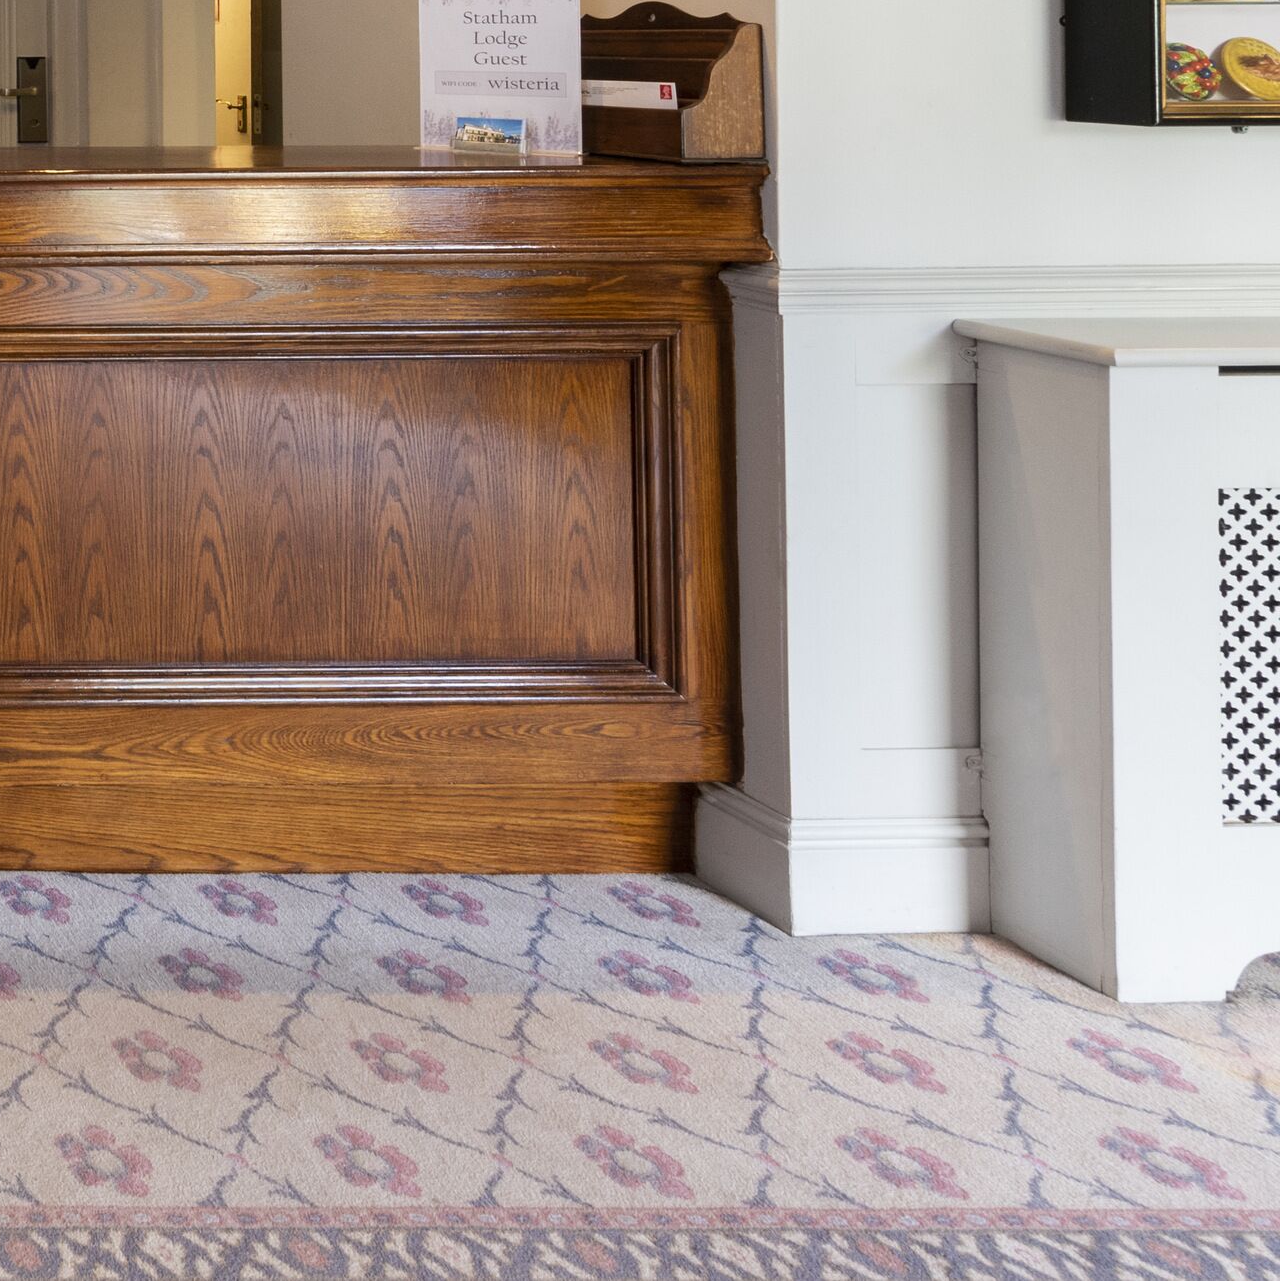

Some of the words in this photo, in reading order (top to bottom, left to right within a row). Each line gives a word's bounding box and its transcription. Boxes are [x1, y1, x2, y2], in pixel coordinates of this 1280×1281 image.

[462, 9, 538, 25] Statham
[472, 30, 528, 49] Lodge
[473, 51, 528, 66] Guest
[487, 76, 560, 91] wisteria
